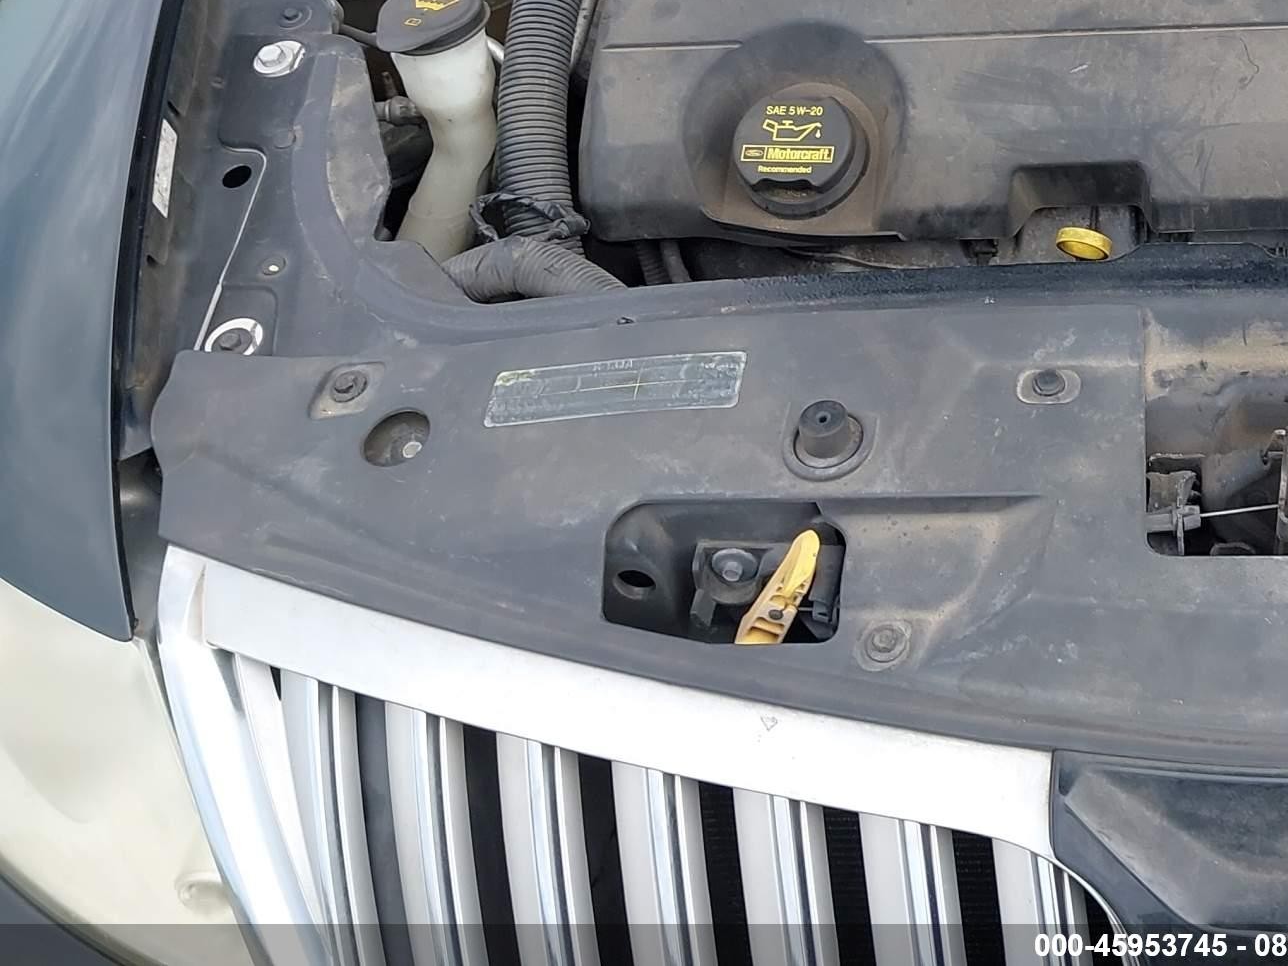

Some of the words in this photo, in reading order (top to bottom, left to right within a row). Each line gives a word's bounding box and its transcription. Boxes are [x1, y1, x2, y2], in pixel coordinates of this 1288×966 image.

[766, 105, 788, 115] SAE
[767, 147, 829, 161] Motorcraft
[757, 165, 813, 174] Recommended
